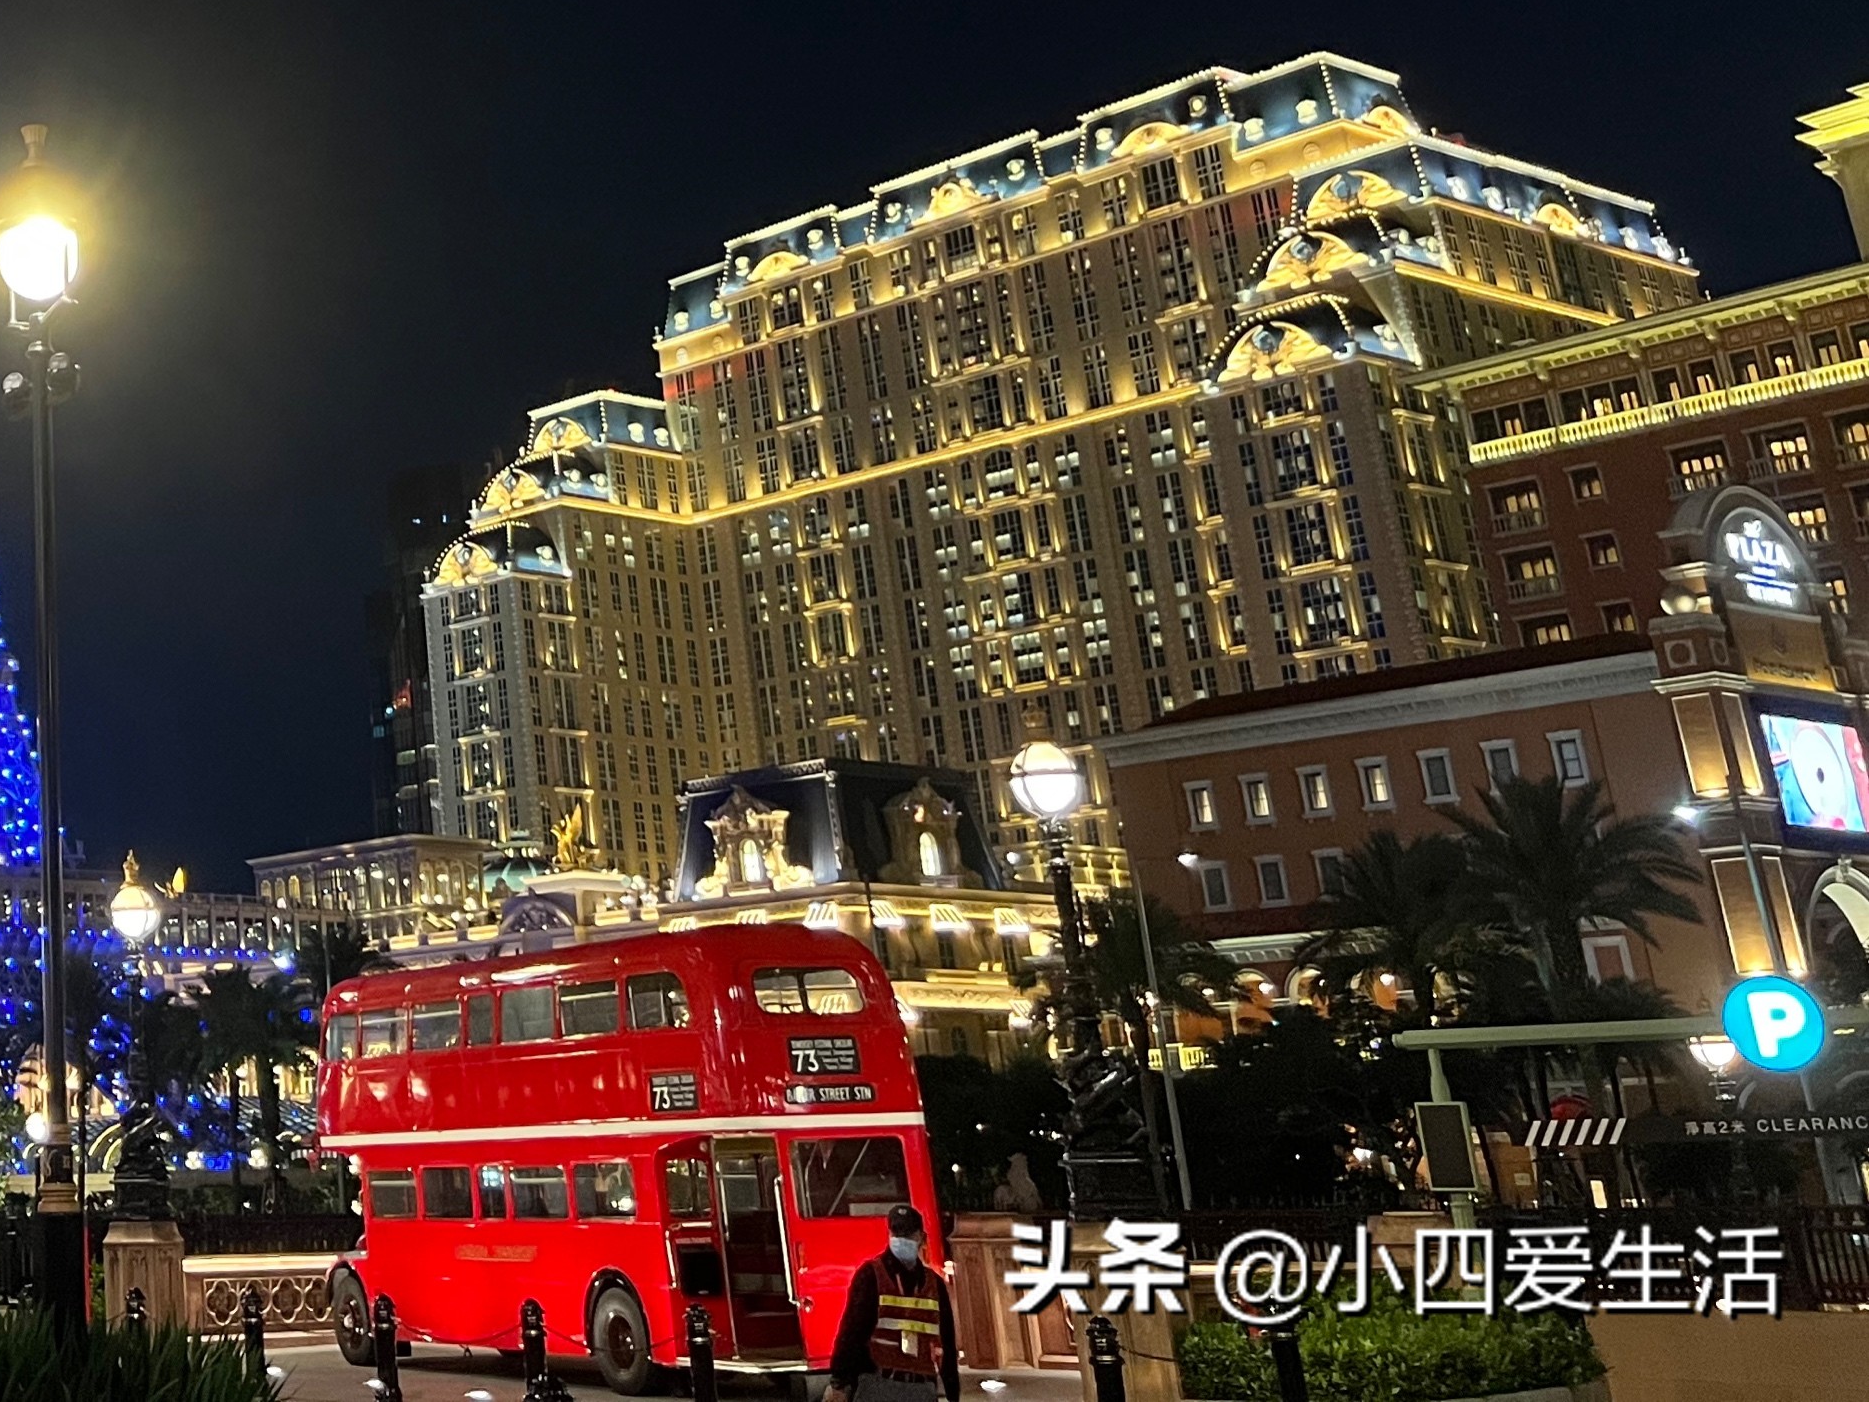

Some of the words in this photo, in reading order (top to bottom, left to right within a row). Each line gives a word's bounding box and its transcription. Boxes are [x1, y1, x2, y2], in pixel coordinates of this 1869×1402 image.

[1746, 991, 1805, 1058] P
[791, 1049, 819, 1072] 73
[652, 1086, 670, 1110] 73
[819, 1087, 850, 1102] STREET
